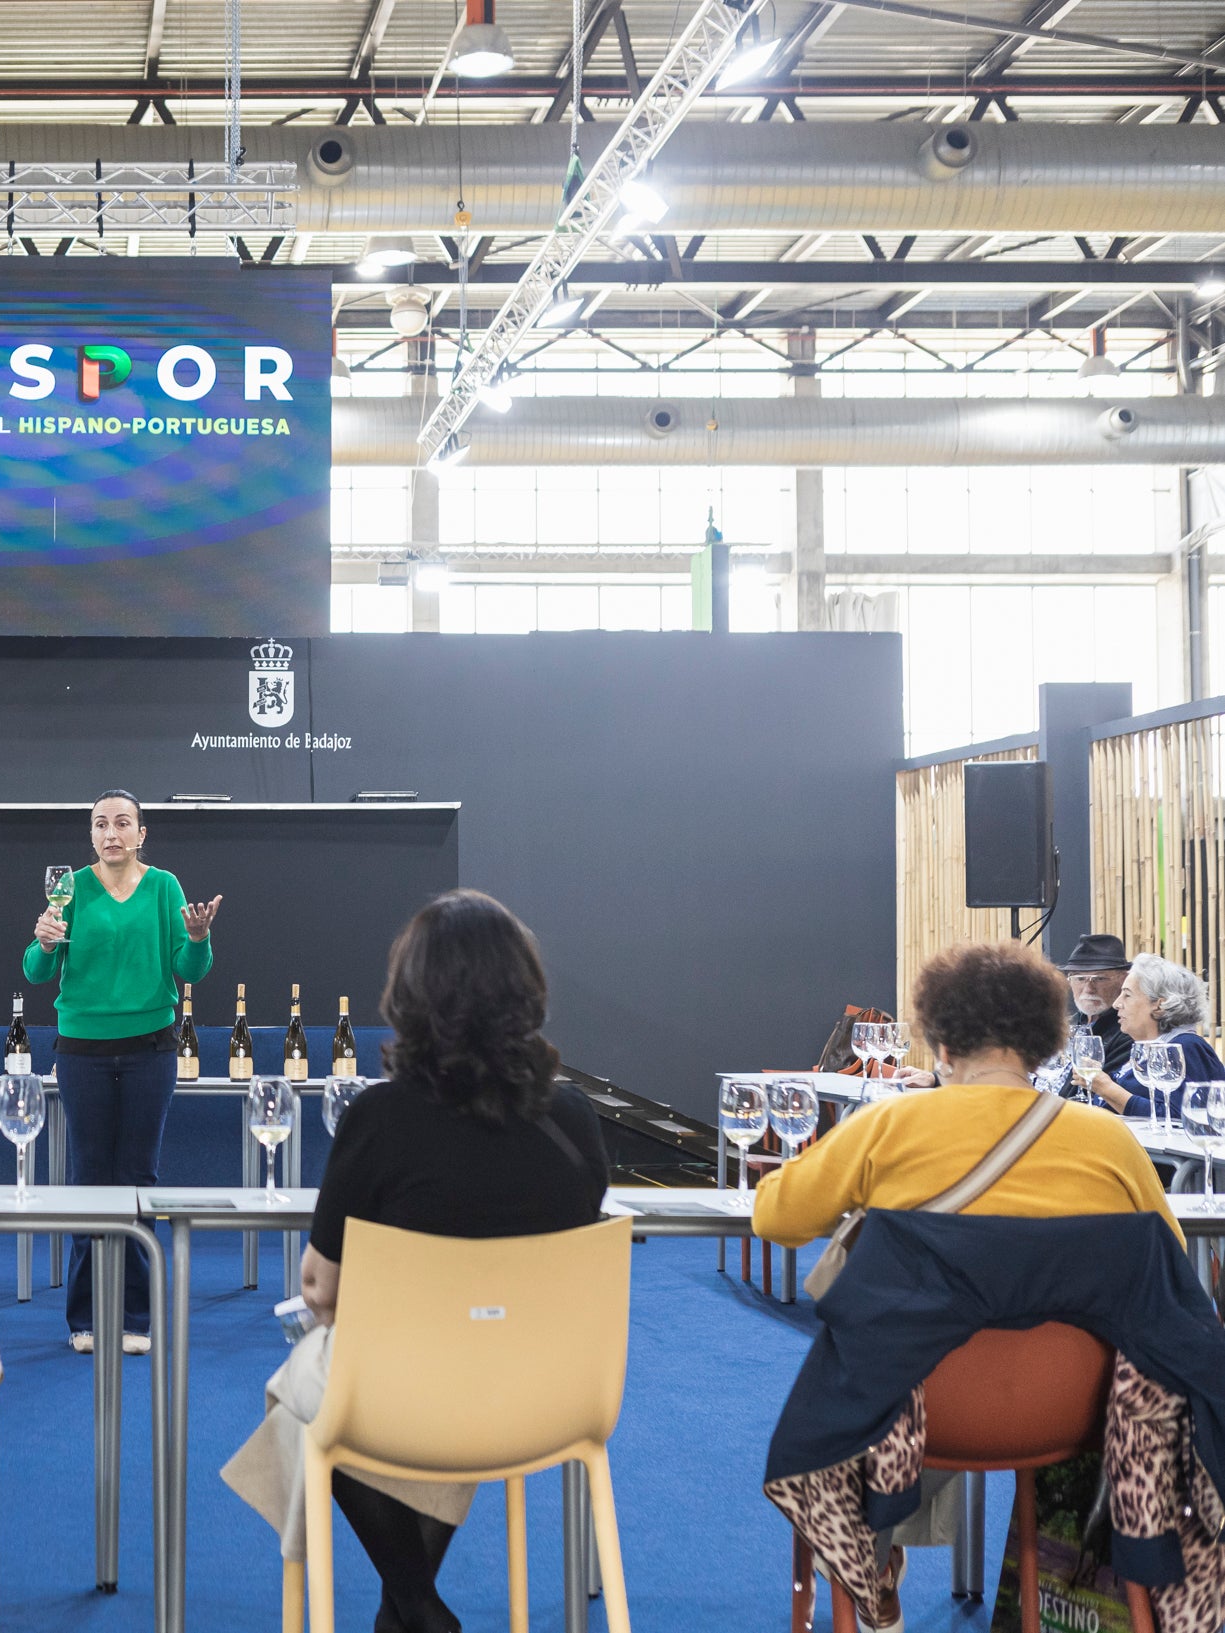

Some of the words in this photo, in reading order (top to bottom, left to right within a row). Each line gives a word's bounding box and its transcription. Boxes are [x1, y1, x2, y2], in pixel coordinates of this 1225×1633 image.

[18, 416, 291, 435] HISPANO-PORTUGUESA
[191, 732, 281, 750] Ayuntamiento
[285, 733, 300, 749] de
[304, 732, 352, 751] Badajoz
